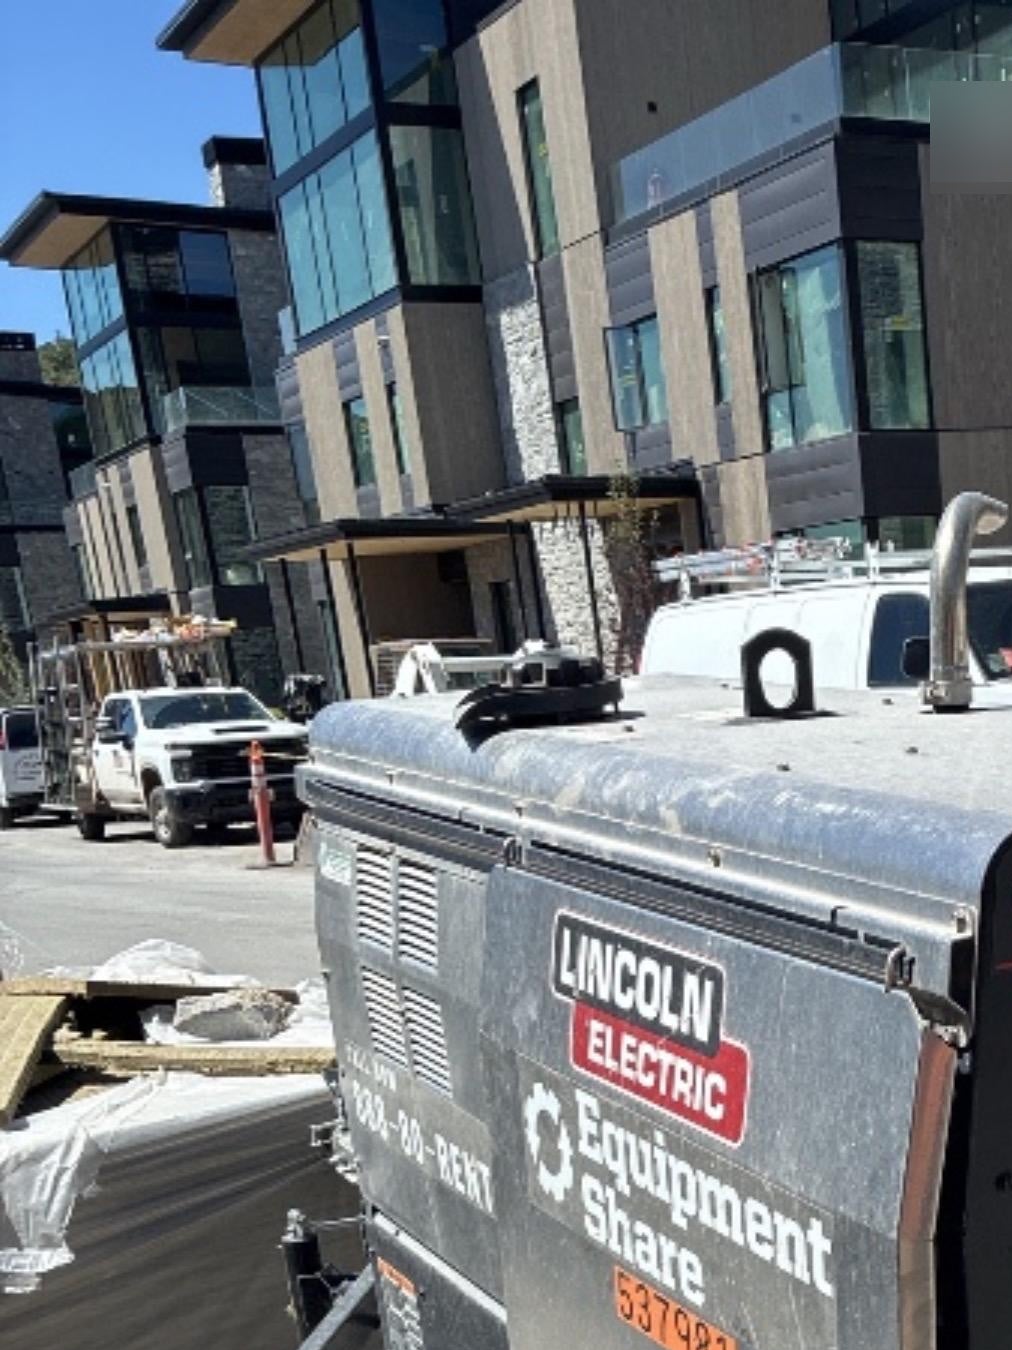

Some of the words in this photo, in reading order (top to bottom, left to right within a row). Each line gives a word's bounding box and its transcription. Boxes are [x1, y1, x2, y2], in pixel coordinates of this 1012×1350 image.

[559, 926, 713, 1043] LINCOLN
[586, 1018, 726, 1121] ELECTRIC
[575, 1087, 835, 1298] Equipment
[580, 1171, 706, 1307] Share
